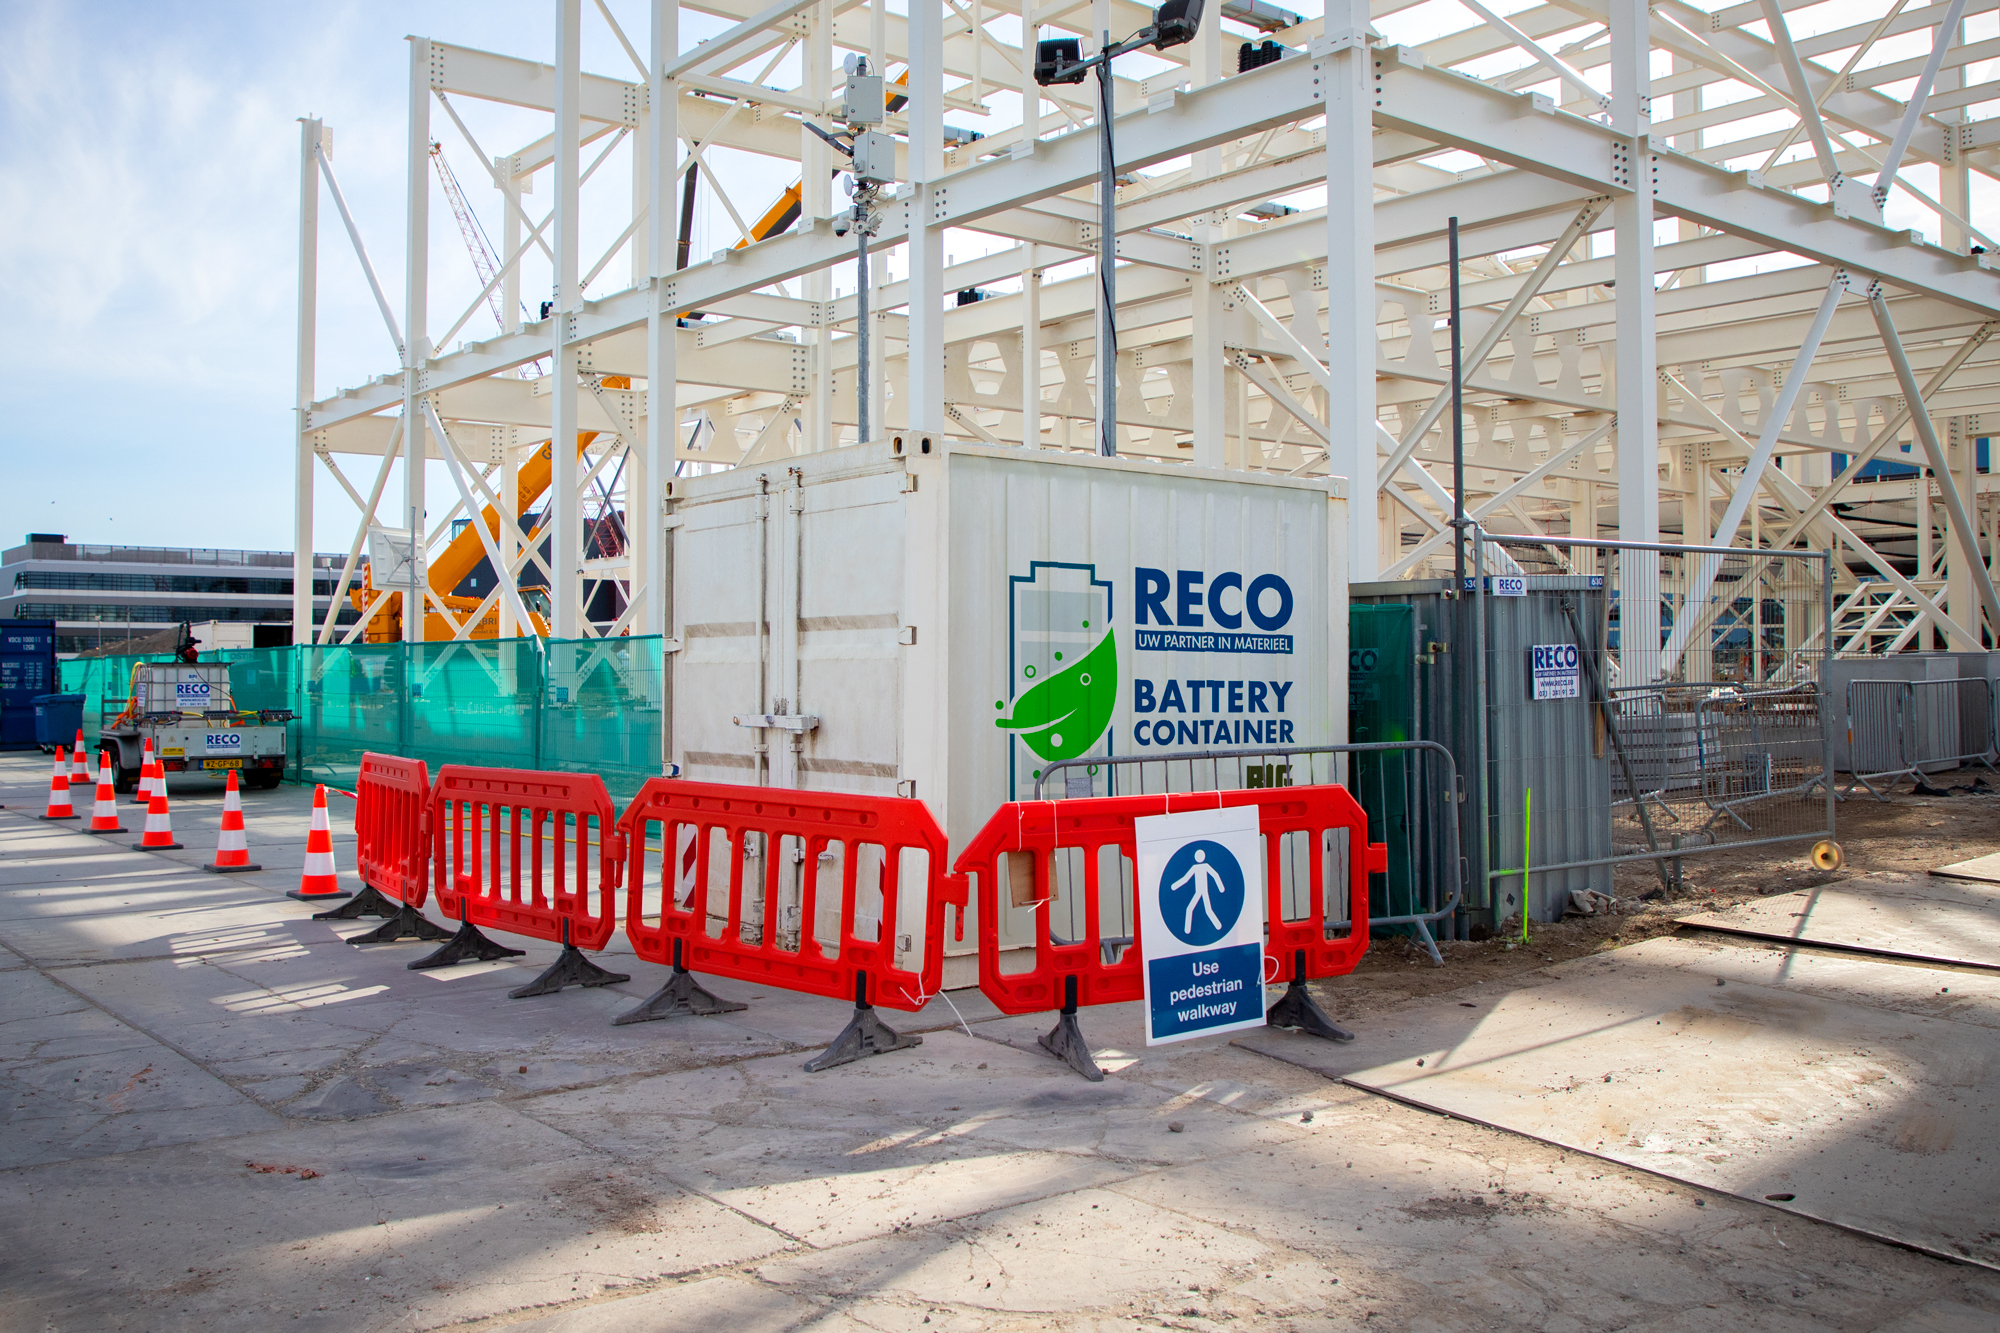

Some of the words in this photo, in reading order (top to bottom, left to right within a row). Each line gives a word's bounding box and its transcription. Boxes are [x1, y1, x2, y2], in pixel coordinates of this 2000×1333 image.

[1499, 579, 1523, 590] RECO
[1135, 567, 1293, 631] RECO
[1138, 633, 1161, 648] UW
[1164, 634, 1215, 649] PARTNER
[1218, 636, 1231, 649] IN
[1234, 637, 1290, 651] MATERIEEL
[1534, 646, 1577, 669] RECO
[177, 684, 210, 694] RECO
[1134, 679, 1293, 713] BATTERY
[206, 734, 240, 744] RECO
[1134, 719, 1295, 746] CONTAINER
[1192, 961, 1220, 977] Use
[1169, 979, 1243, 1006] pedestrian
[1177, 1001, 1237, 1022] walkway
